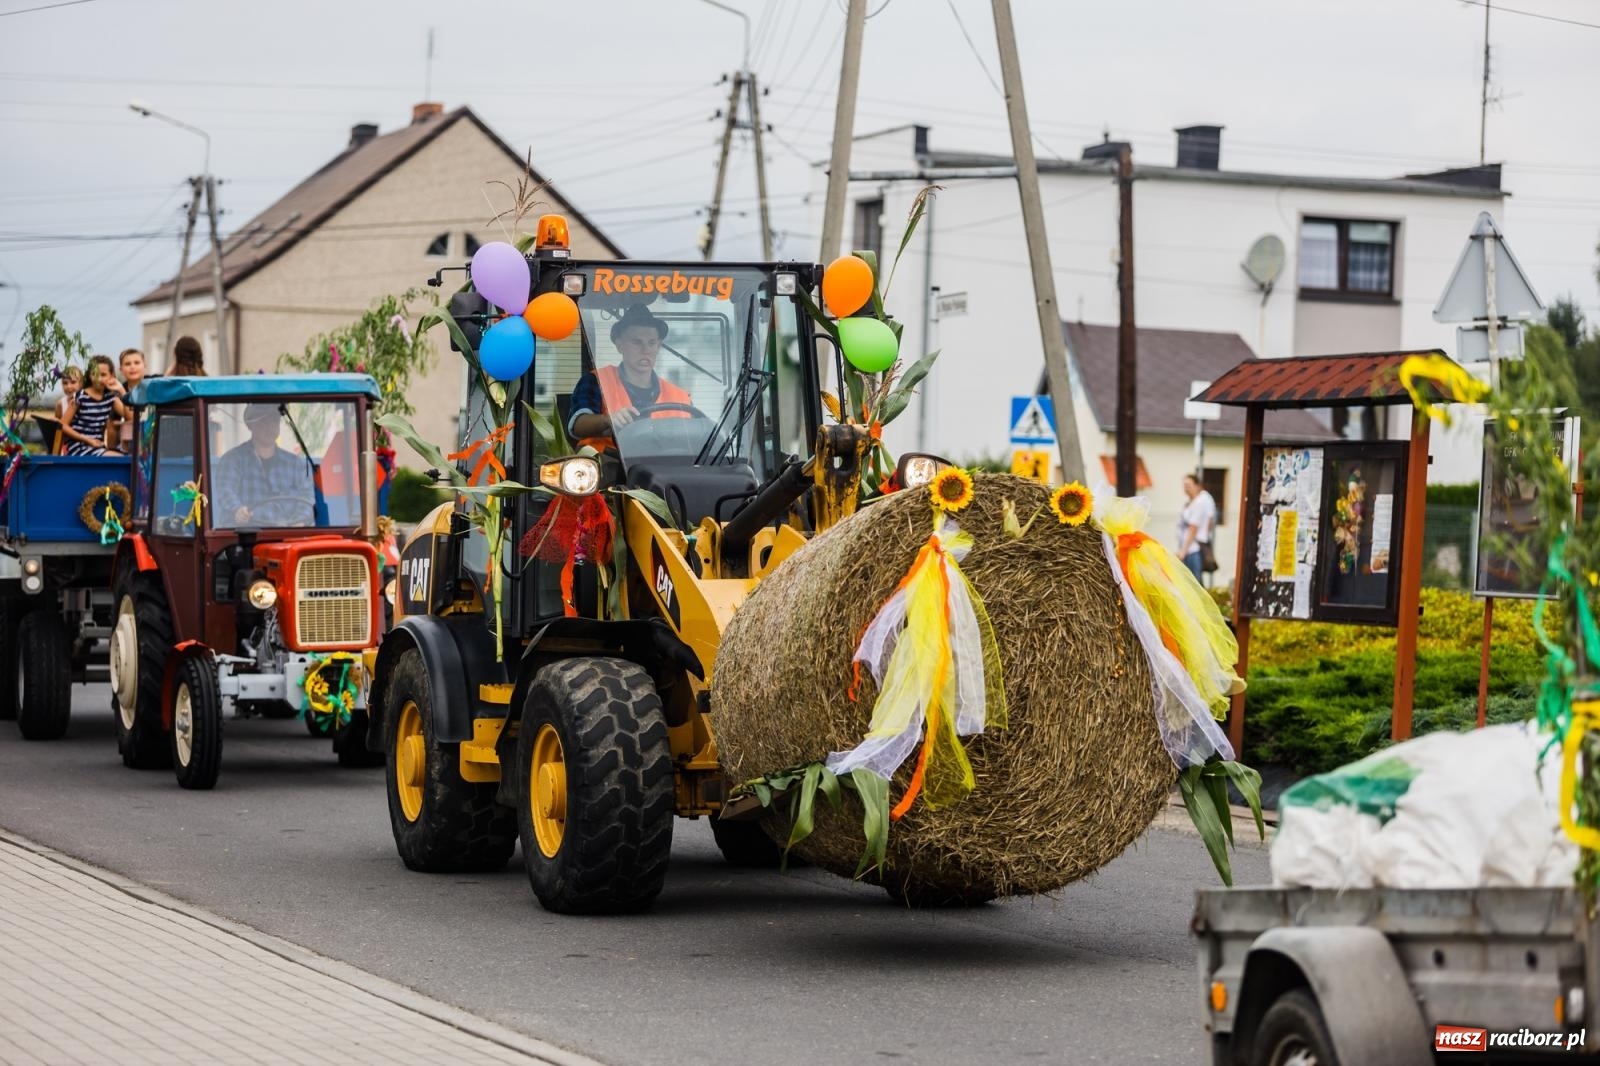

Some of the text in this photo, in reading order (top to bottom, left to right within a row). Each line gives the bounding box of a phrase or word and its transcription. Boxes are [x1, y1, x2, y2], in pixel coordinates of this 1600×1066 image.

[592, 268, 735, 301] Rosseburg
[409, 557, 431, 602] CAT
[656, 564, 674, 609] CAT
